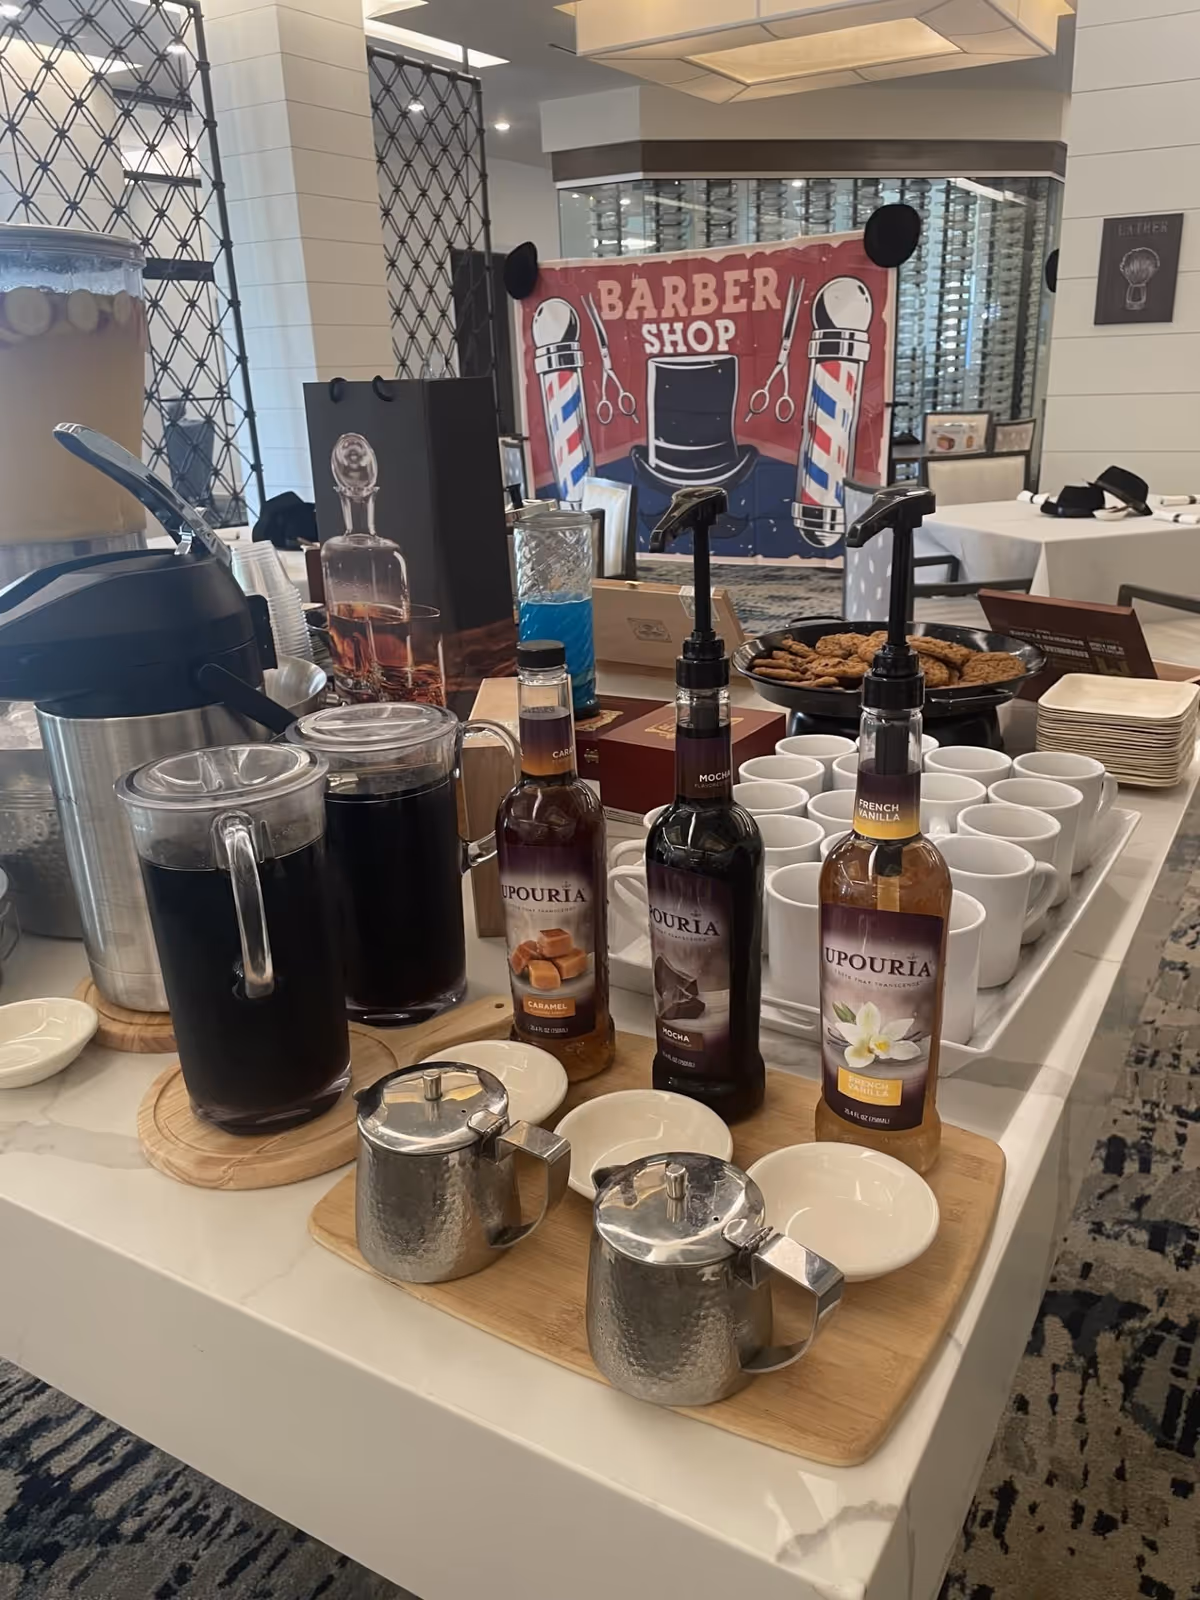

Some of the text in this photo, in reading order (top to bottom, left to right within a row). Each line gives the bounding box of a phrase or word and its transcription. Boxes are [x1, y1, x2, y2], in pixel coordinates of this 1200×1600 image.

[597, 266, 782, 321] BARBER
[641, 318, 736, 354] SHOP
[699, 769, 731, 782] MOCHA
[859, 798, 900, 812] FRENCH
[858, 808, 901, 822] VANILLA
[527, 1000, 568, 1011] CARAMEL
[662, 1026, 691, 1043] MOCHA
